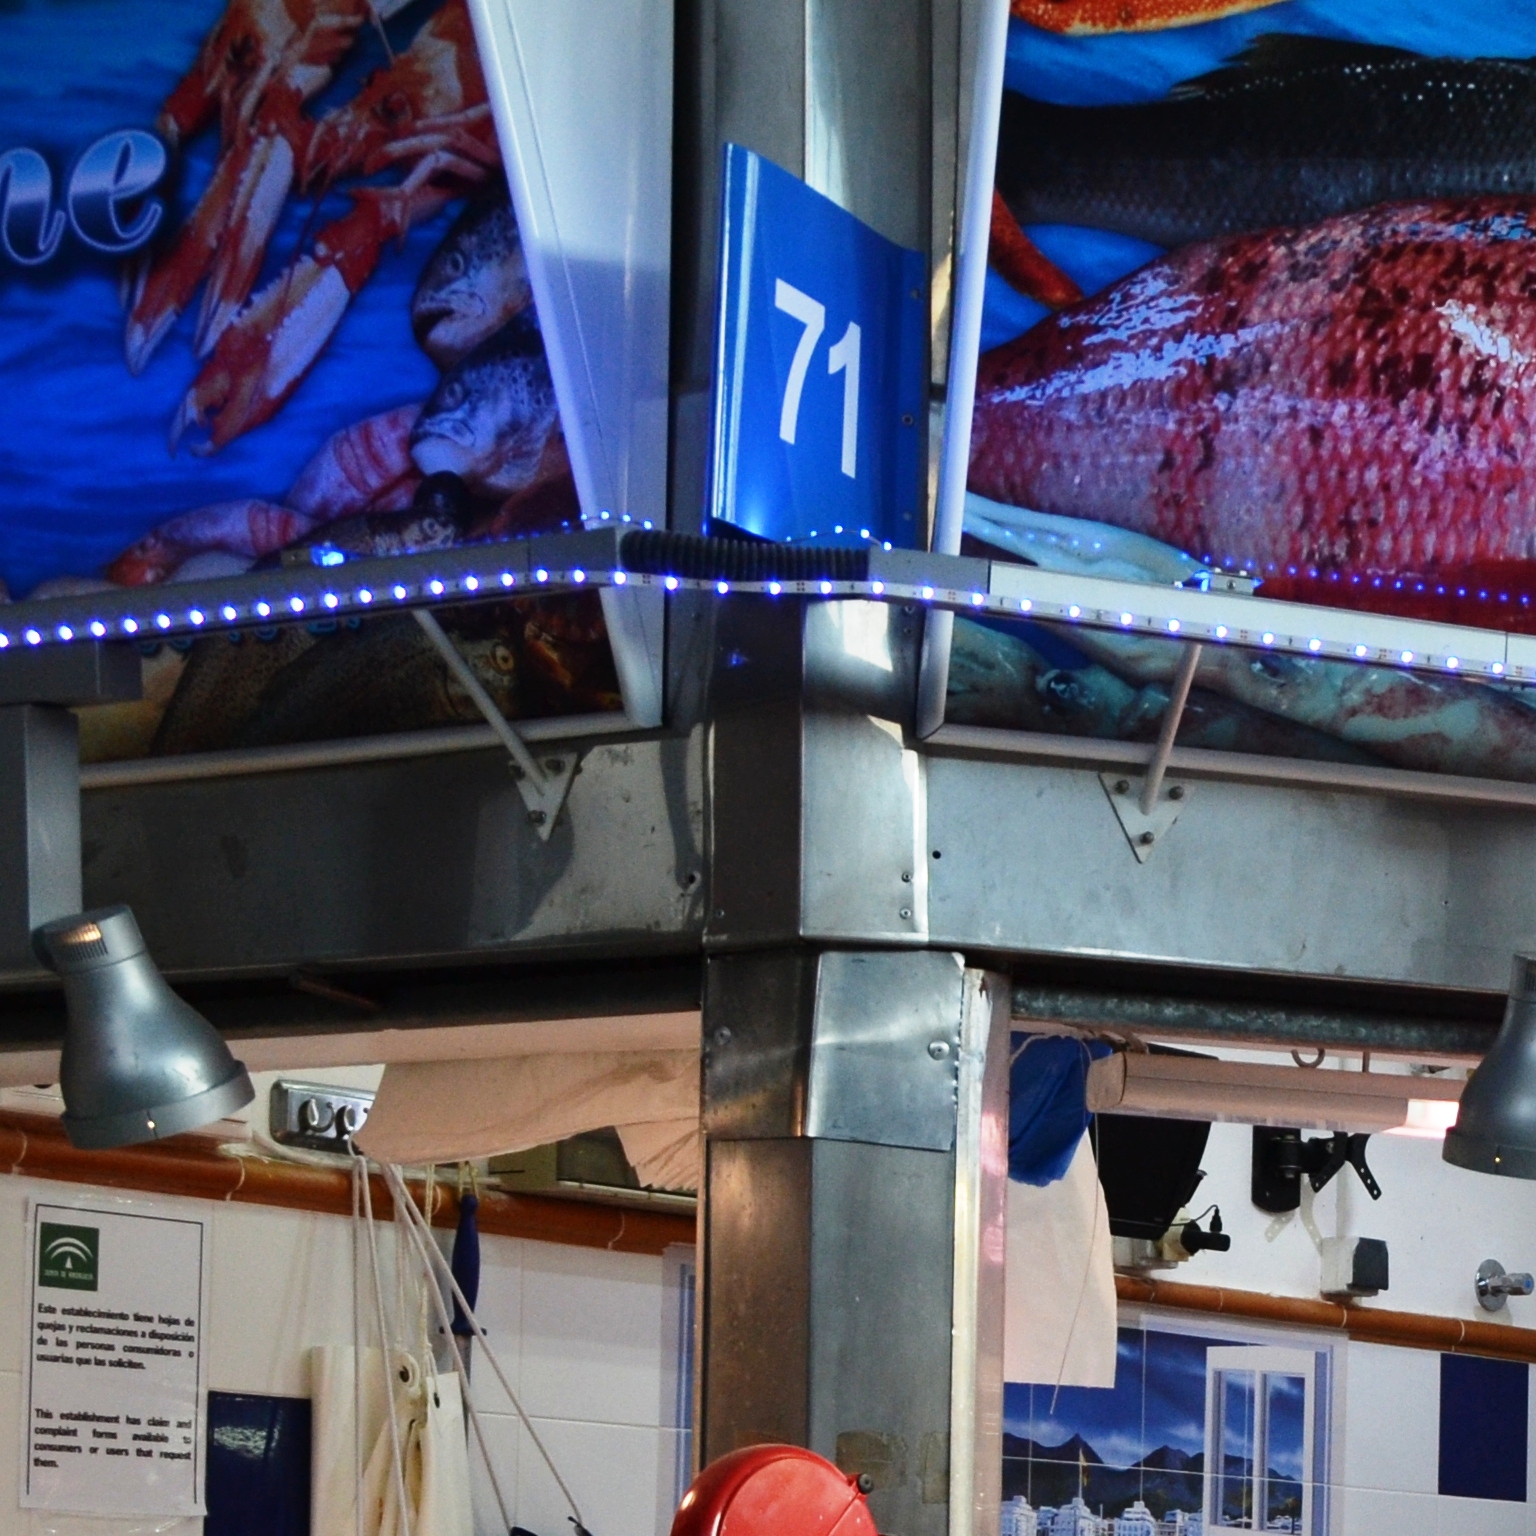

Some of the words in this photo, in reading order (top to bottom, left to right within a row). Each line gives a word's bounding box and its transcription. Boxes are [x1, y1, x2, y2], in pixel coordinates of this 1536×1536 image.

[772, 278, 863, 479] 71
[38, 1303, 57, 1314] Este
[61, 1307, 129, 1321] establecimiento
[133, 1313, 154, 1323] tiene
[158, 1315, 180, 1327] hojas
[184, 1318, 195, 1327] de
[37, 1321, 66, 1333] quejas
[68, 1324, 73, 1334] y
[76, 1324, 138, 1338] reclamaciones
[37, 1336, 48, 1346] de
[56, 1337, 68, 1348] las
[76, 1340, 115, 1351] personas
[123, 1344, 181, 1357] consumidoras
[37, 1353, 73, 1364] usuarias
[76, 1357, 92, 1367] que
[94, 1357, 106, 1367] las
[35, 1408, 53, 1419] This
[60, 1411, 119, 1424] establishment
[126, 1415, 141, 1425] has
[147, 1416, 170, 1427] claim
[176, 1419, 192, 1429] and
[34, 1425, 78, 1437] complaint
[92, 1428, 117, 1440] forms
[132, 1432, 169, 1443] available
[183, 1435, 191, 1444] to
[34, 1443, 82, 1453] consumers
[89, 1446, 99, 1454] or
[106, 1447, 129, 1456] users
[136, 1447, 153, 1457] that
[159, 1450, 191, 1461] request
[34, 1457, 59, 1468] them.
